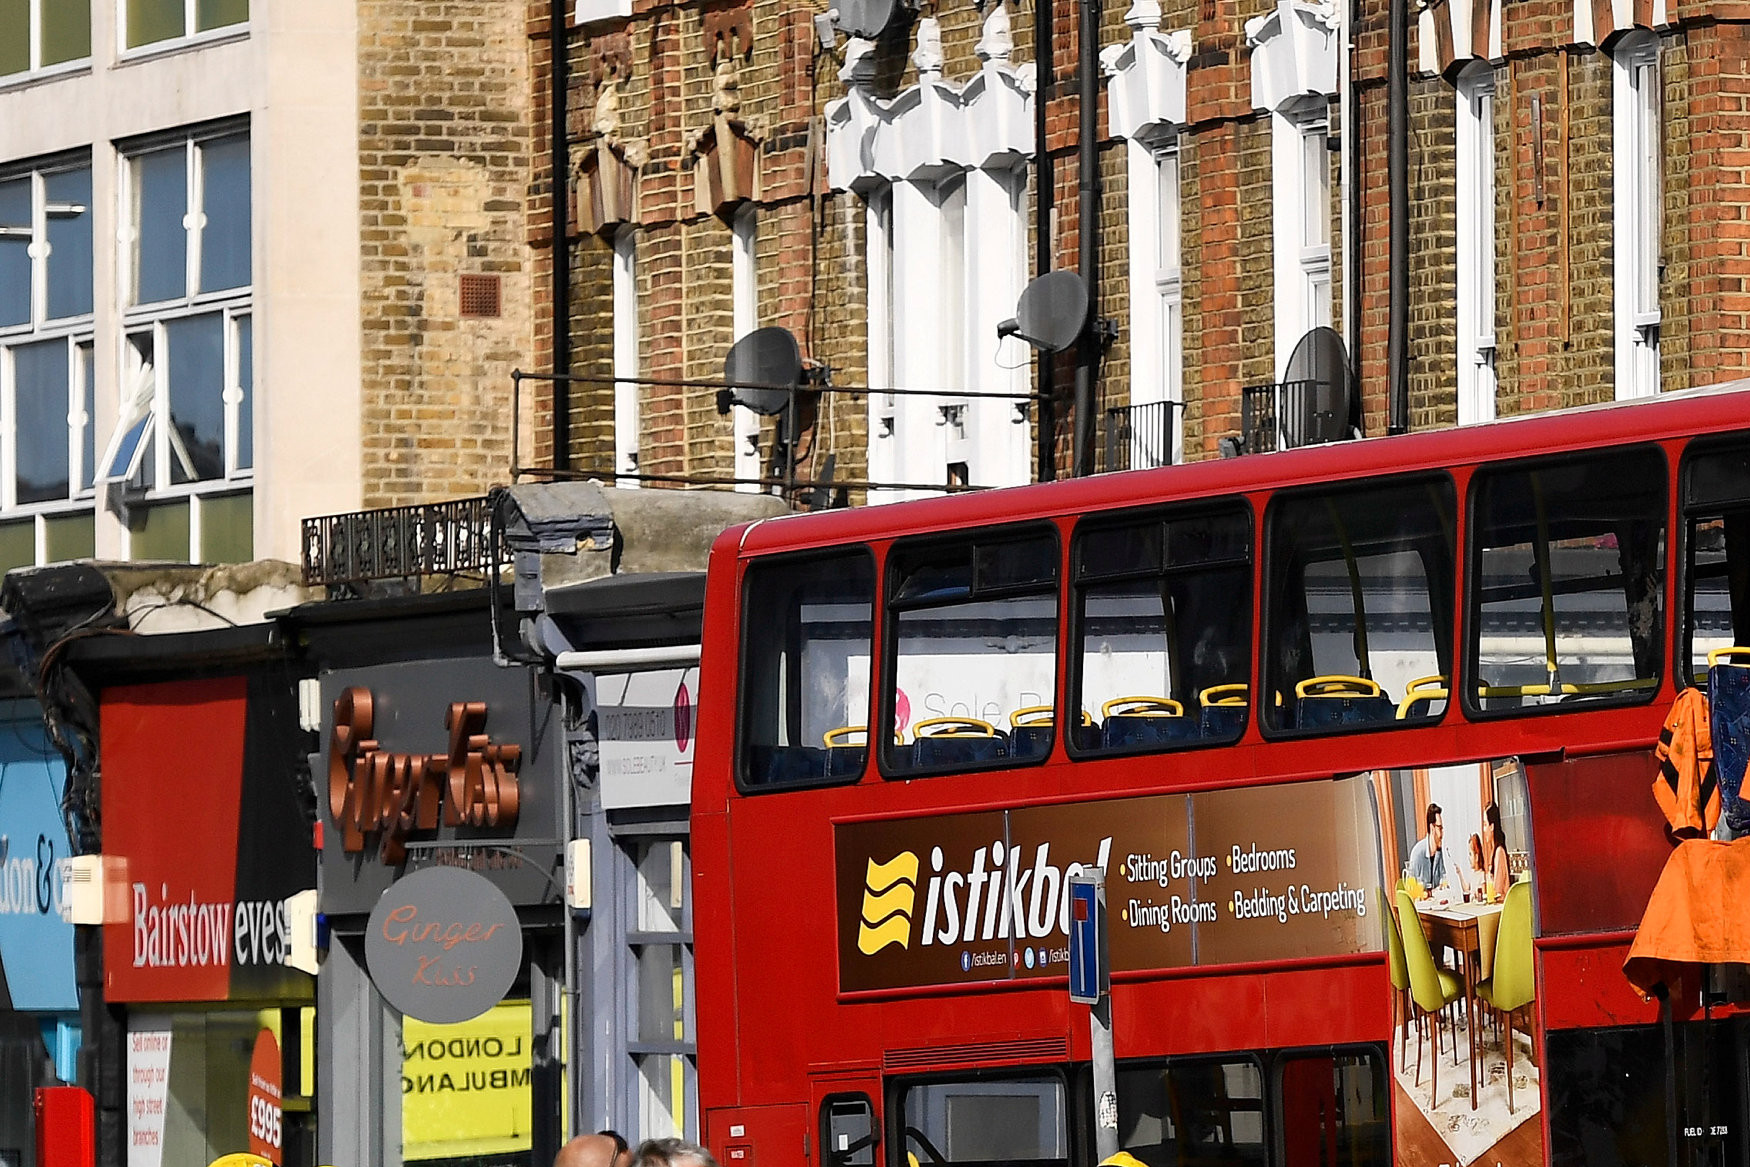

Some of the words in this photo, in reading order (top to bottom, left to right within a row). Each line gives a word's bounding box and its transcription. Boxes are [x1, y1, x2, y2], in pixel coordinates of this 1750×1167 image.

[1127, 854, 1168, 888] Sitting
[1170, 850, 1217, 885] Groups
[1232, 842, 1296, 875] Bedrooms
[1129, 898, 1170, 933] Dining
[1171, 895, 1217, 925] Rooms
[1234, 887, 1289, 924] Bedding
[1288, 885, 1300, 915] &
[1301, 882, 1366, 919] Carpeting
[132, 881, 230, 968] Bairstow
[234, 900, 286, 966] eves
[382, 905, 504, 950] Ginger
[251, 1095, 282, 1149] £995
